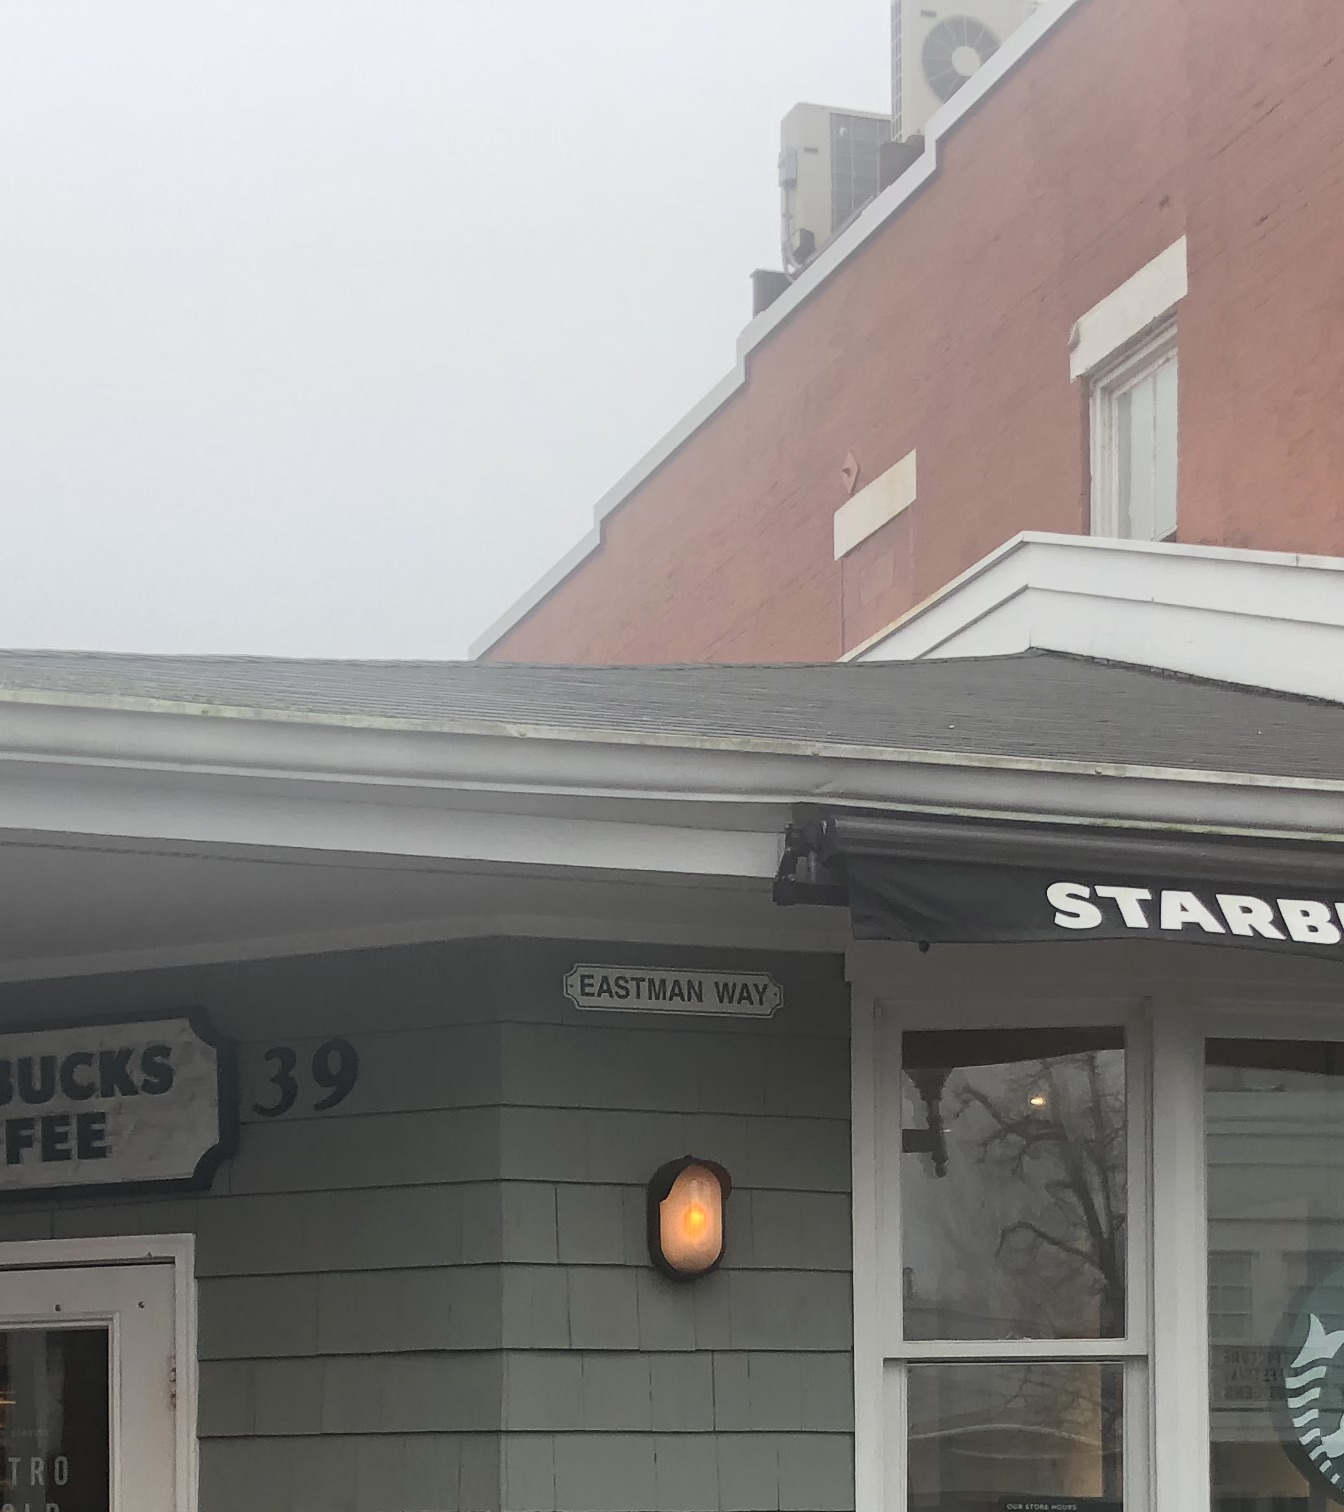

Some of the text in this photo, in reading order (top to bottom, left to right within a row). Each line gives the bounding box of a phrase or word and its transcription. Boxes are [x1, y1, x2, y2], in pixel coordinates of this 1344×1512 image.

[579, 974, 769, 1006] EASTMAN WAY
[252, 1037, 358, 1118] 39
